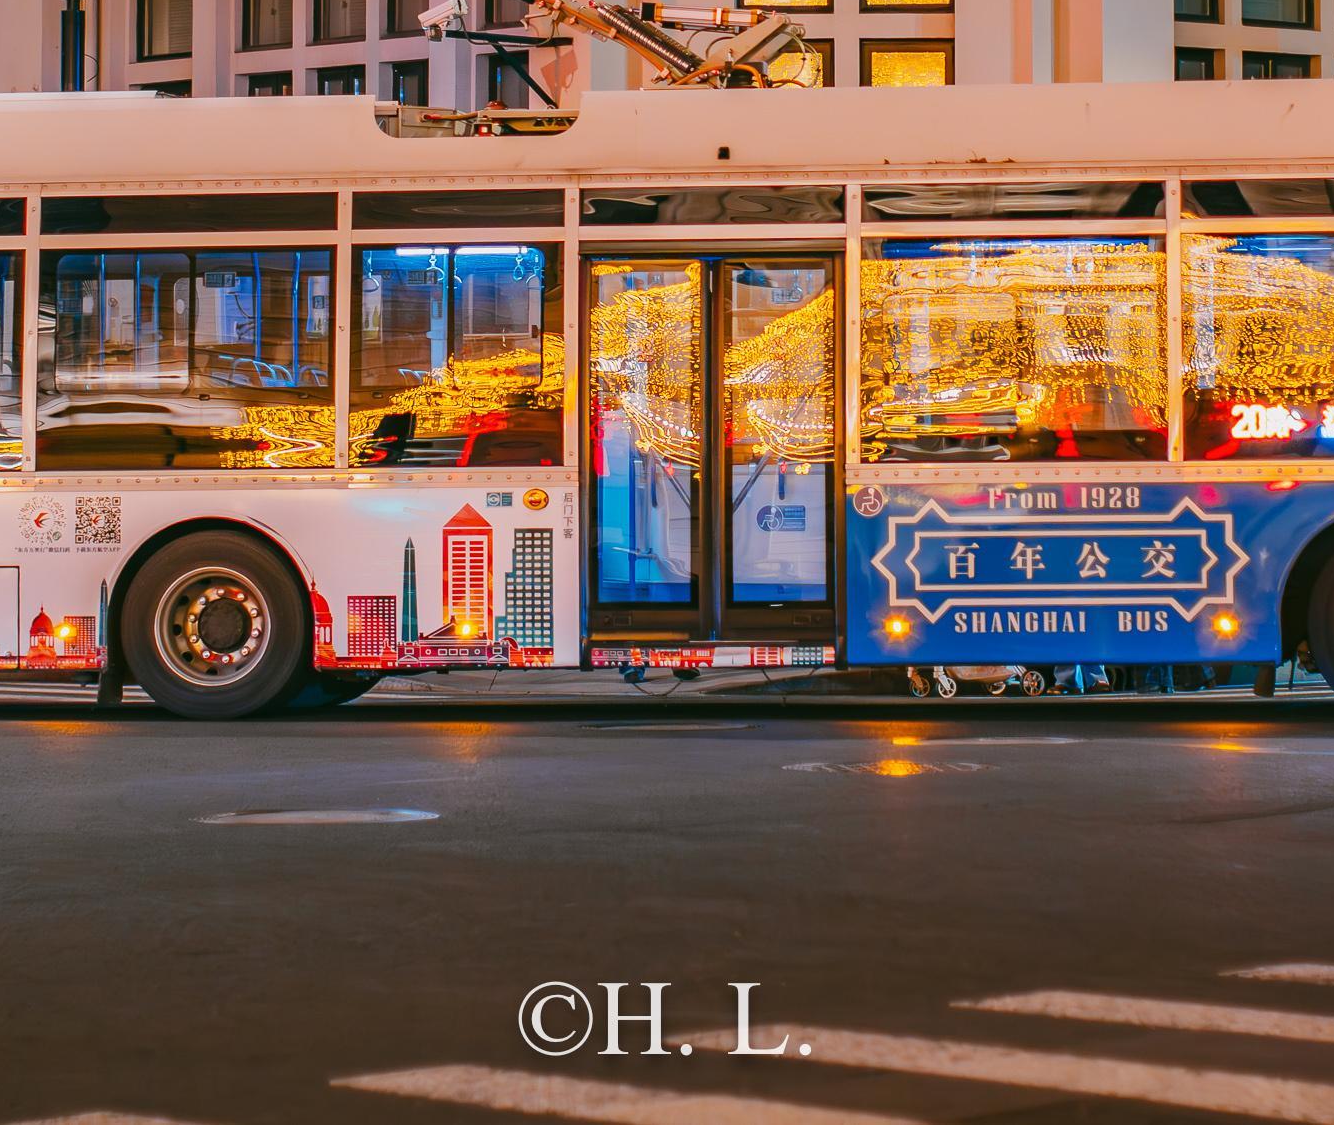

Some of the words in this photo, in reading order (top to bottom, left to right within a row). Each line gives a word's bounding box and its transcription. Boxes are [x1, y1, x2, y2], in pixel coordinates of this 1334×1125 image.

[988, 487, 1057, 510] From
[1080, 487, 1140, 509] 1928
[563, 492, 574, 539] 后门下客
[943, 541, 1177, 580] 百年公交
[954, 611, 1086, 634] SHANGHAI
[1117, 610, 1169, 633] BUS
